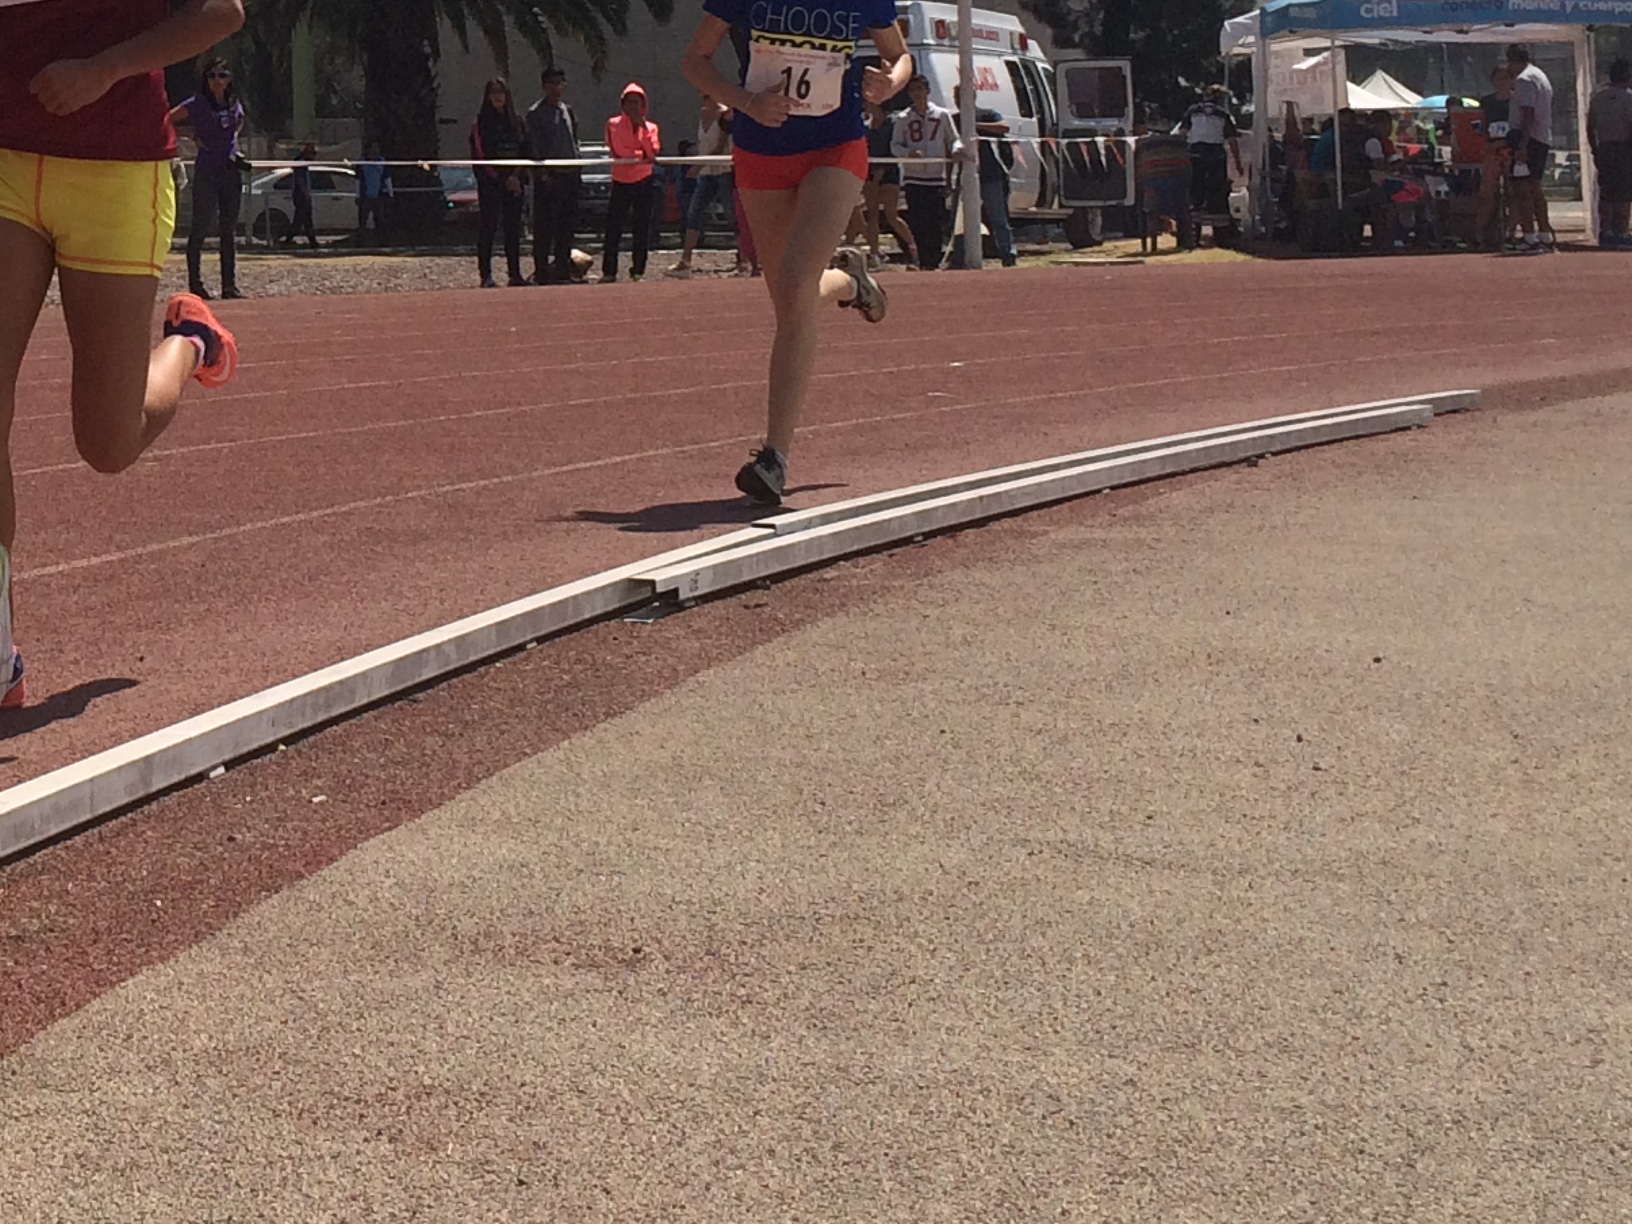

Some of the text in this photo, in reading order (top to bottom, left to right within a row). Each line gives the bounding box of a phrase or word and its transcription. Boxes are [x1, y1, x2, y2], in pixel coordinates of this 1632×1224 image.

[750, 0, 861, 40] CHOOSE
[1359, 0, 1399, 18] ciel
[780, 66, 811, 100] 16
[907, 119, 942, 143] 87
